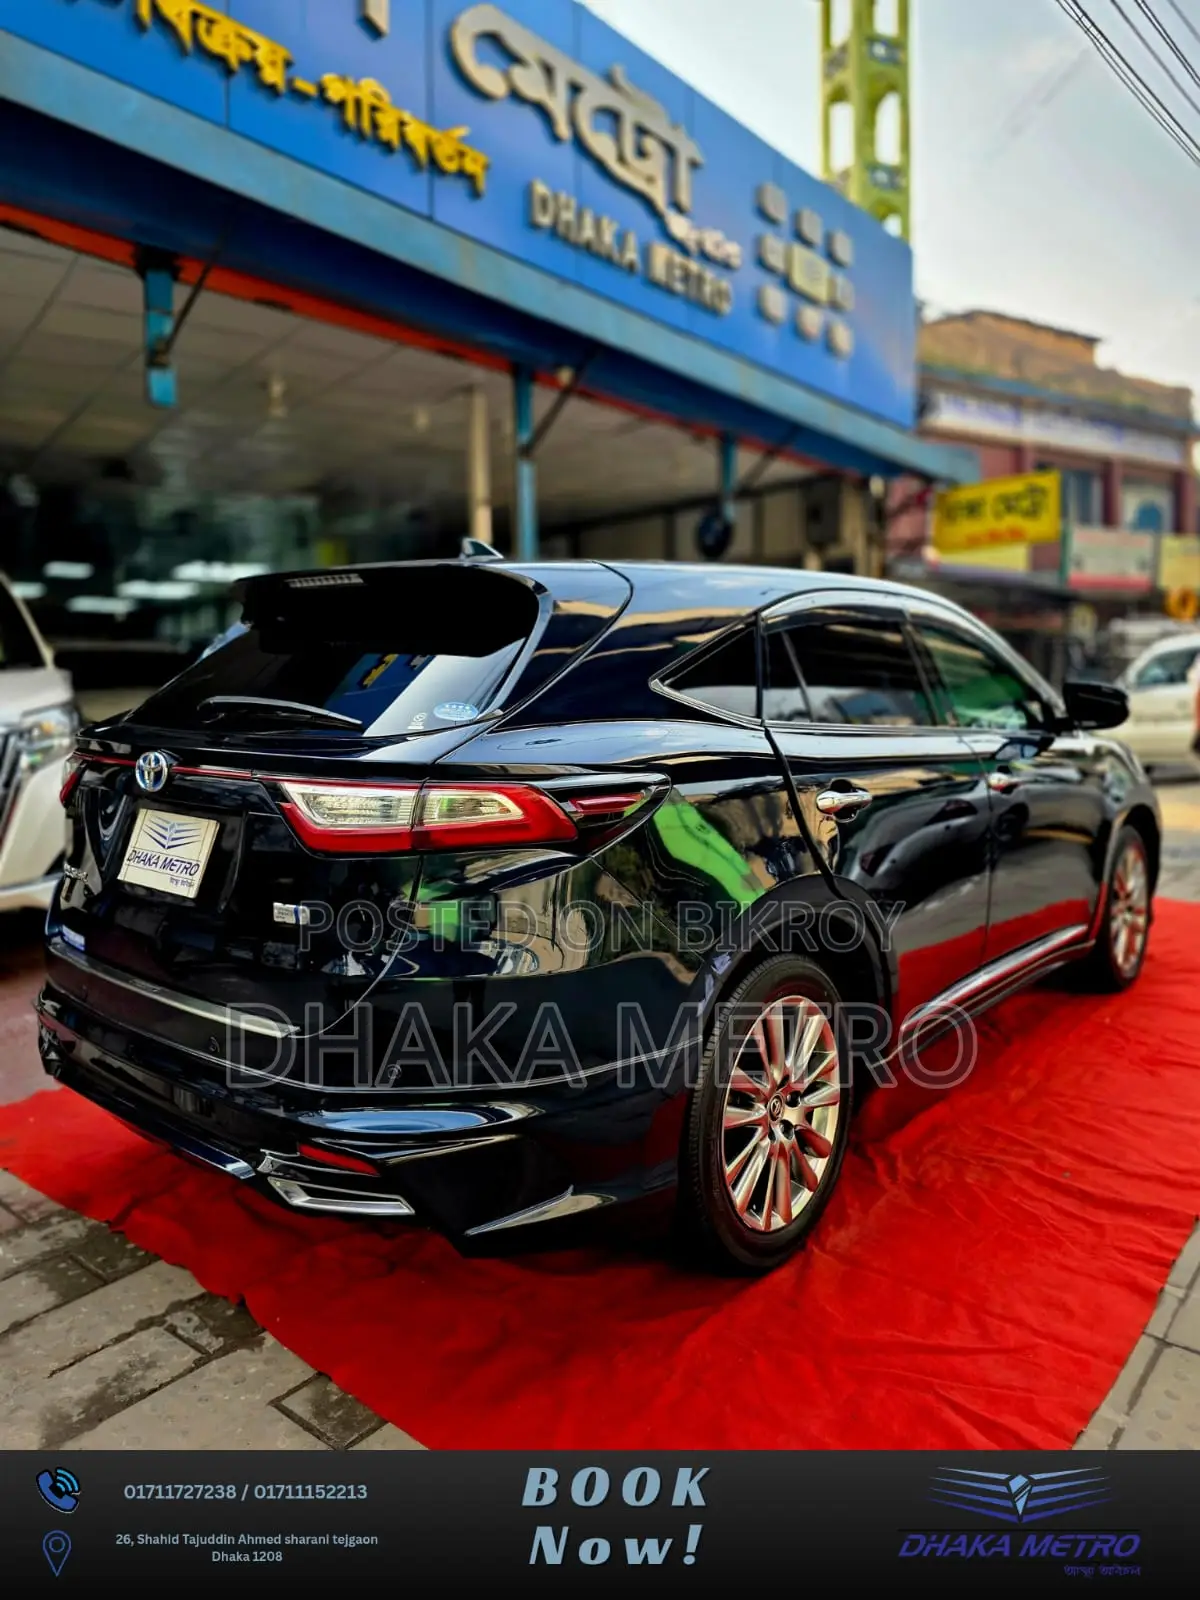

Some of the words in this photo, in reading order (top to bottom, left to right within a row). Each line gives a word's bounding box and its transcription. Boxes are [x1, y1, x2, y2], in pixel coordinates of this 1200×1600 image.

[451, 4, 703, 217] মেট্রো
[530, 179, 639, 273] DHAKA
[649, 242, 733, 316] METRO
[127, 850, 159, 869] DHAKA
[160, 857, 200, 877] METRO
